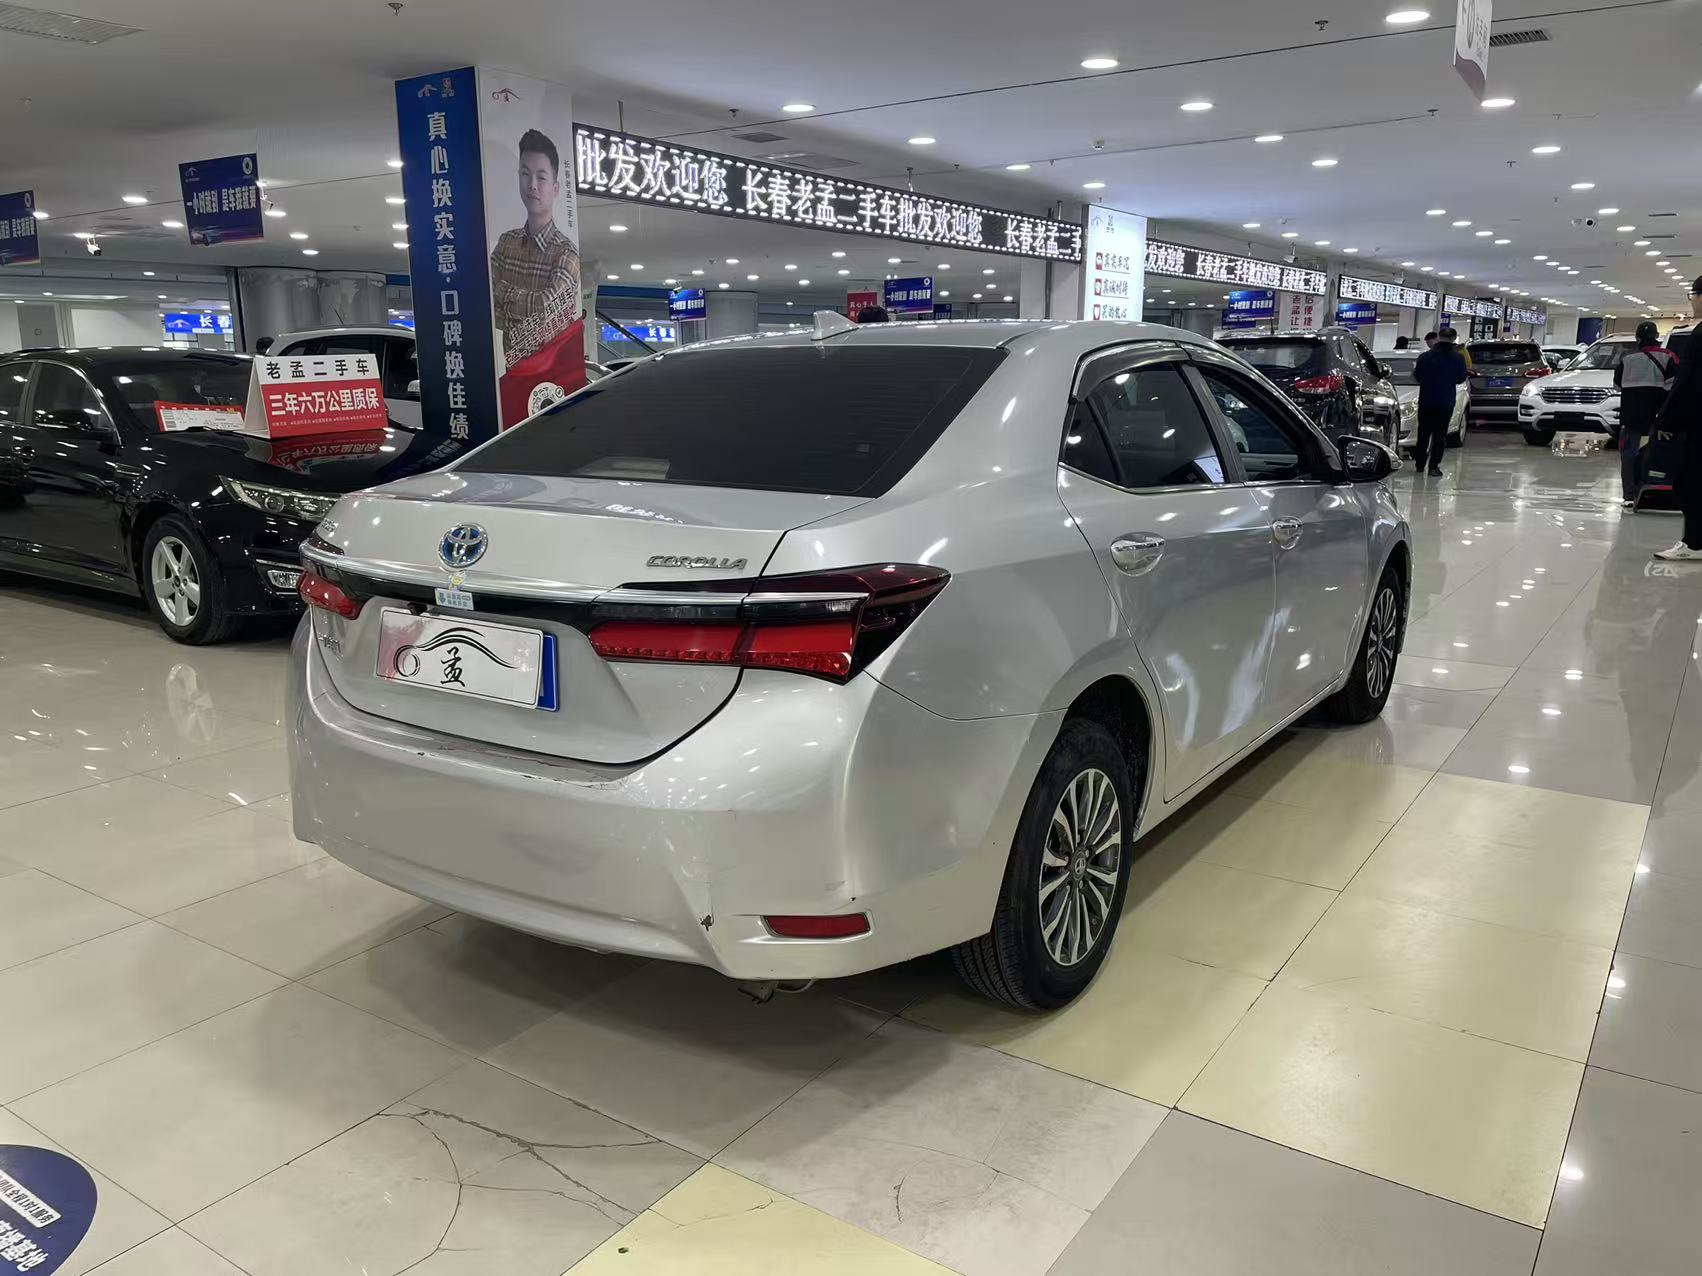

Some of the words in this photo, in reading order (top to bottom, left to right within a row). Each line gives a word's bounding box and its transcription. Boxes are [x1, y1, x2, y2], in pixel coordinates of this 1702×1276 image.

[577, 133, 728, 205] 批发欢迎您
[742, 168, 982, 243] 长春老孟二手车批发欢迎您
[266, 358, 370, 379] 老孟二手车
[269, 387, 380, 416] 三年六万公里质保
[647, 555, 748, 570] COROLLA
[440, 646, 466, 688] 孟
